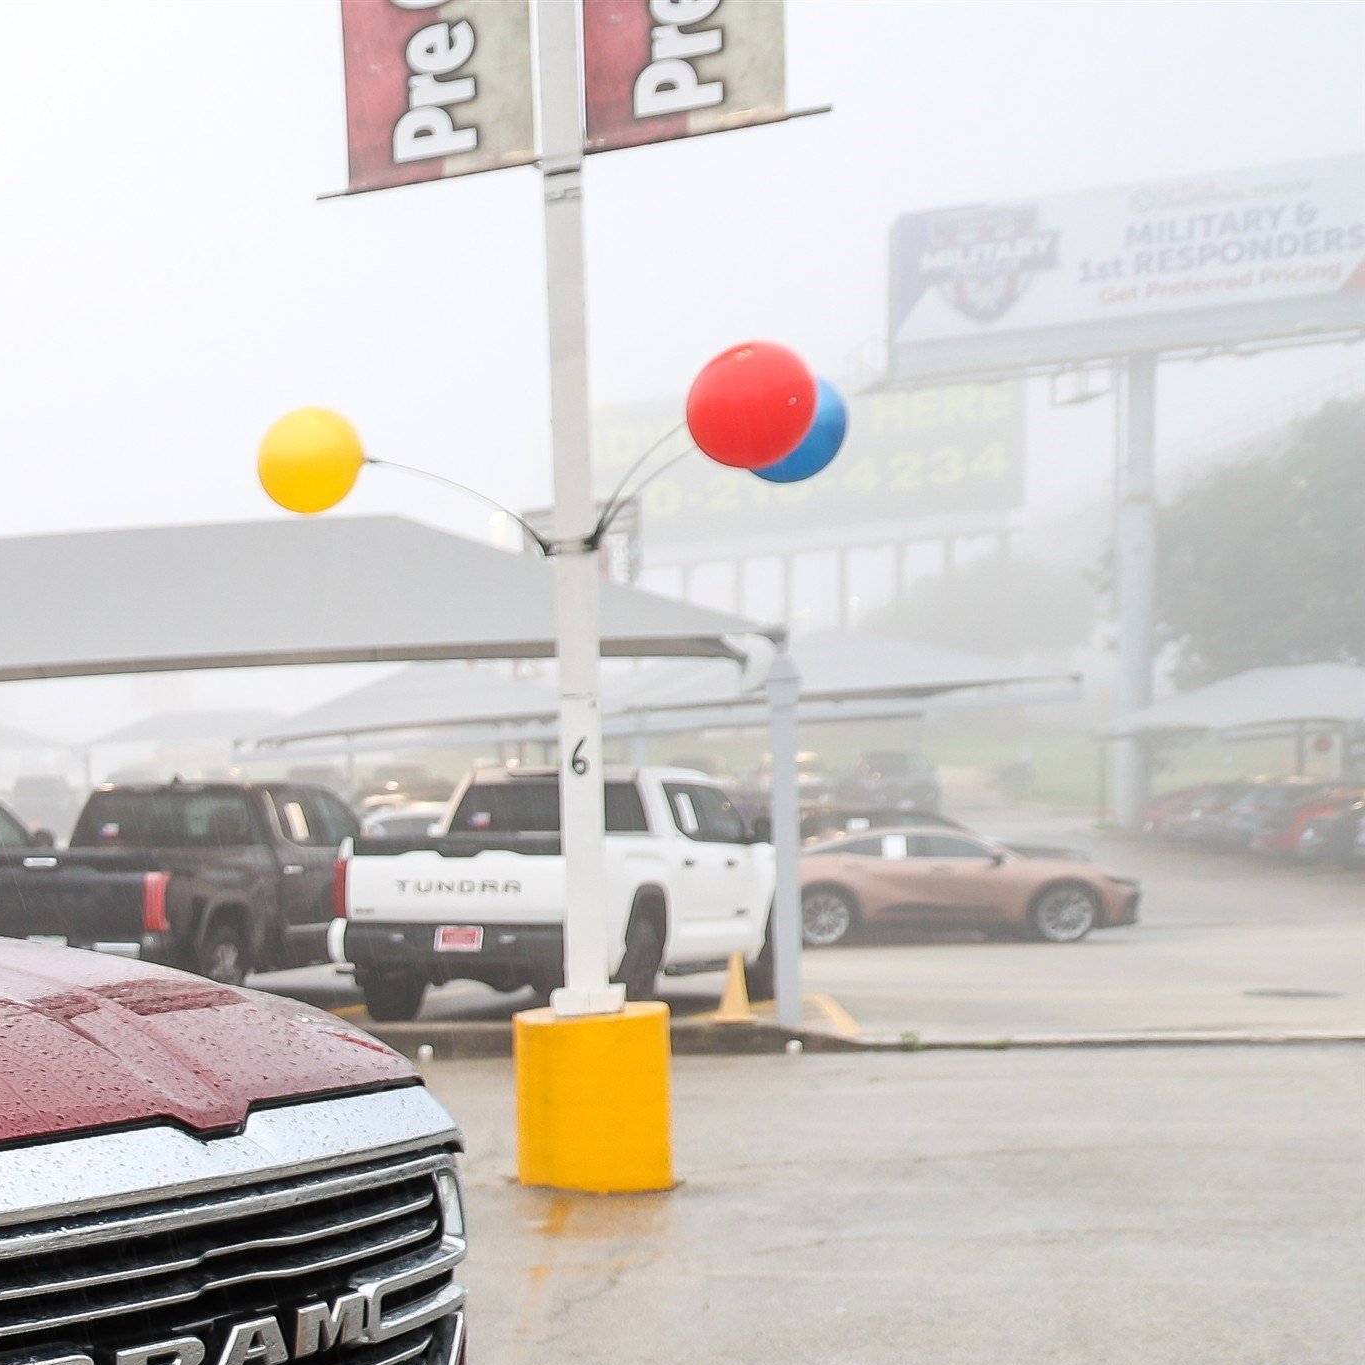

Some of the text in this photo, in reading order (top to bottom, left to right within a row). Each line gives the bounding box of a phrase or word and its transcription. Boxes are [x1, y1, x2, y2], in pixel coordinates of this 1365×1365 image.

[392, 18, 478, 164] Pre
[1126, 199, 1319, 247] MILITARY &
[1078, 221, 1365, 284] 1st RESPONDERS
[570, 736, 590, 775] 6
[396, 878, 523, 894] TUNDRA
